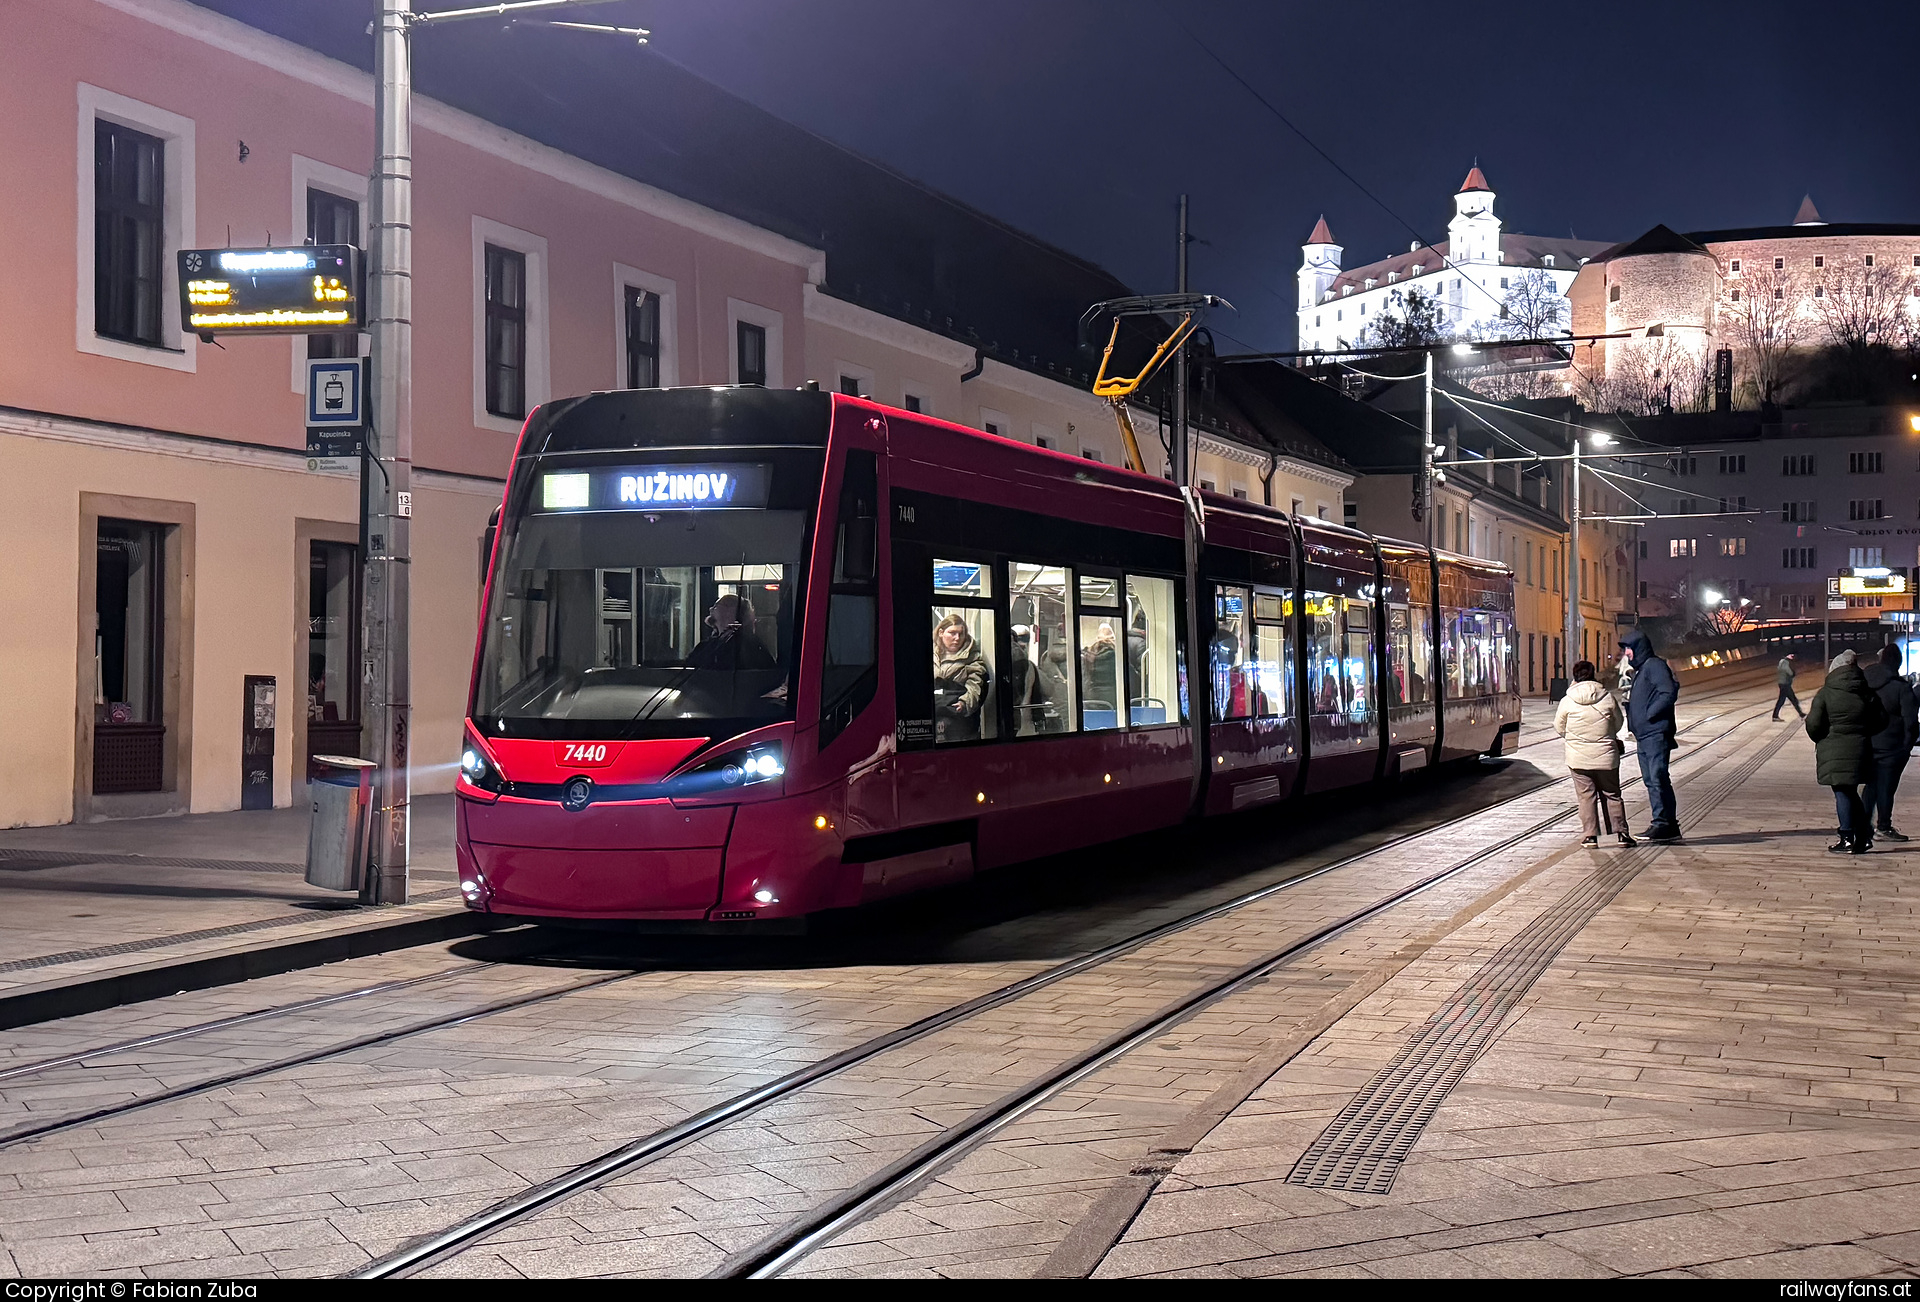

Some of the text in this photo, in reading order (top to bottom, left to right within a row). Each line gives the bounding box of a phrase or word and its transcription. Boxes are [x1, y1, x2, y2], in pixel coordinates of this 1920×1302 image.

[621, 472, 728, 502] RUŽINOV
[405, 506, 410, 515] 0
[899, 505, 915, 523] 7440
[563, 744, 607, 762] 7440
